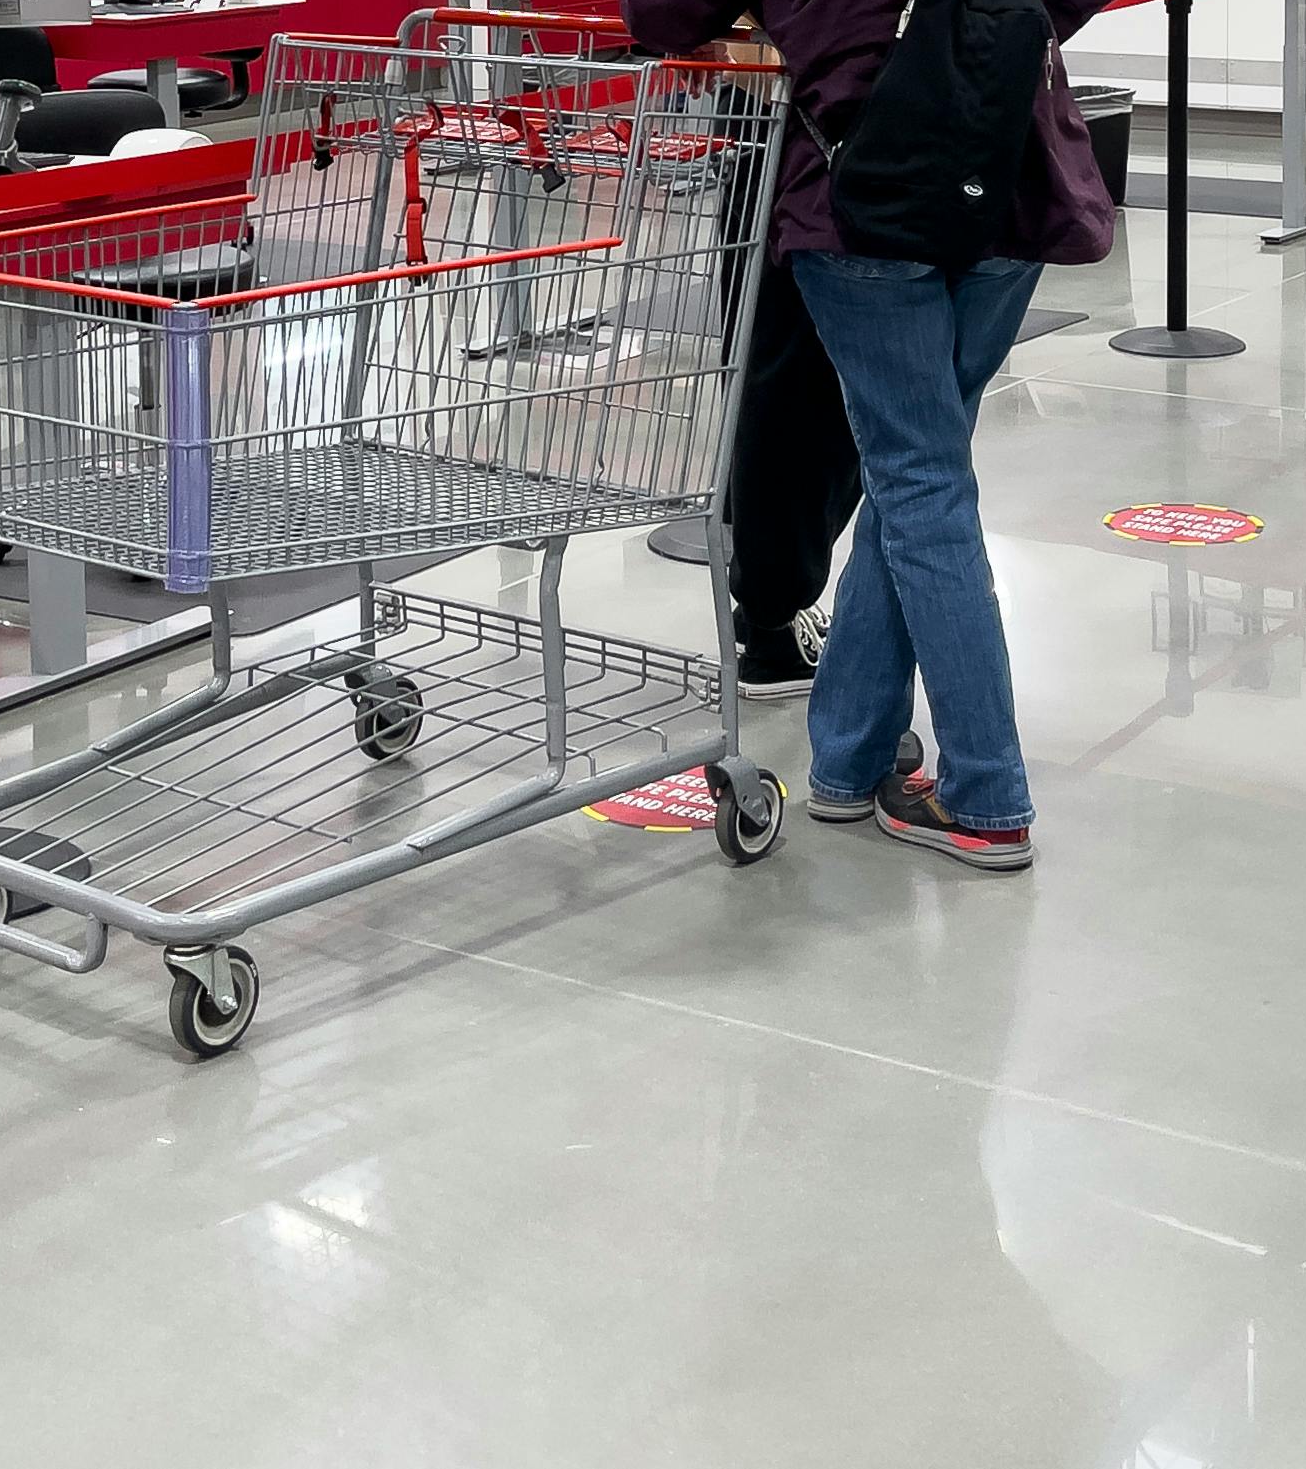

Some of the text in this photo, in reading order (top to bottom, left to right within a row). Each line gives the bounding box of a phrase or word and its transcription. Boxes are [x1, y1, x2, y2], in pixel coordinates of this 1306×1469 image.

[1132, 514, 1234, 533] SAFE PLEASE
[1143, 508, 1246, 528] TO KEEP YOU
[1121, 521, 1223, 540] STAND HERE
[608, 793, 664, 811] TAND
[635, 782, 719, 808] FE PLEA
